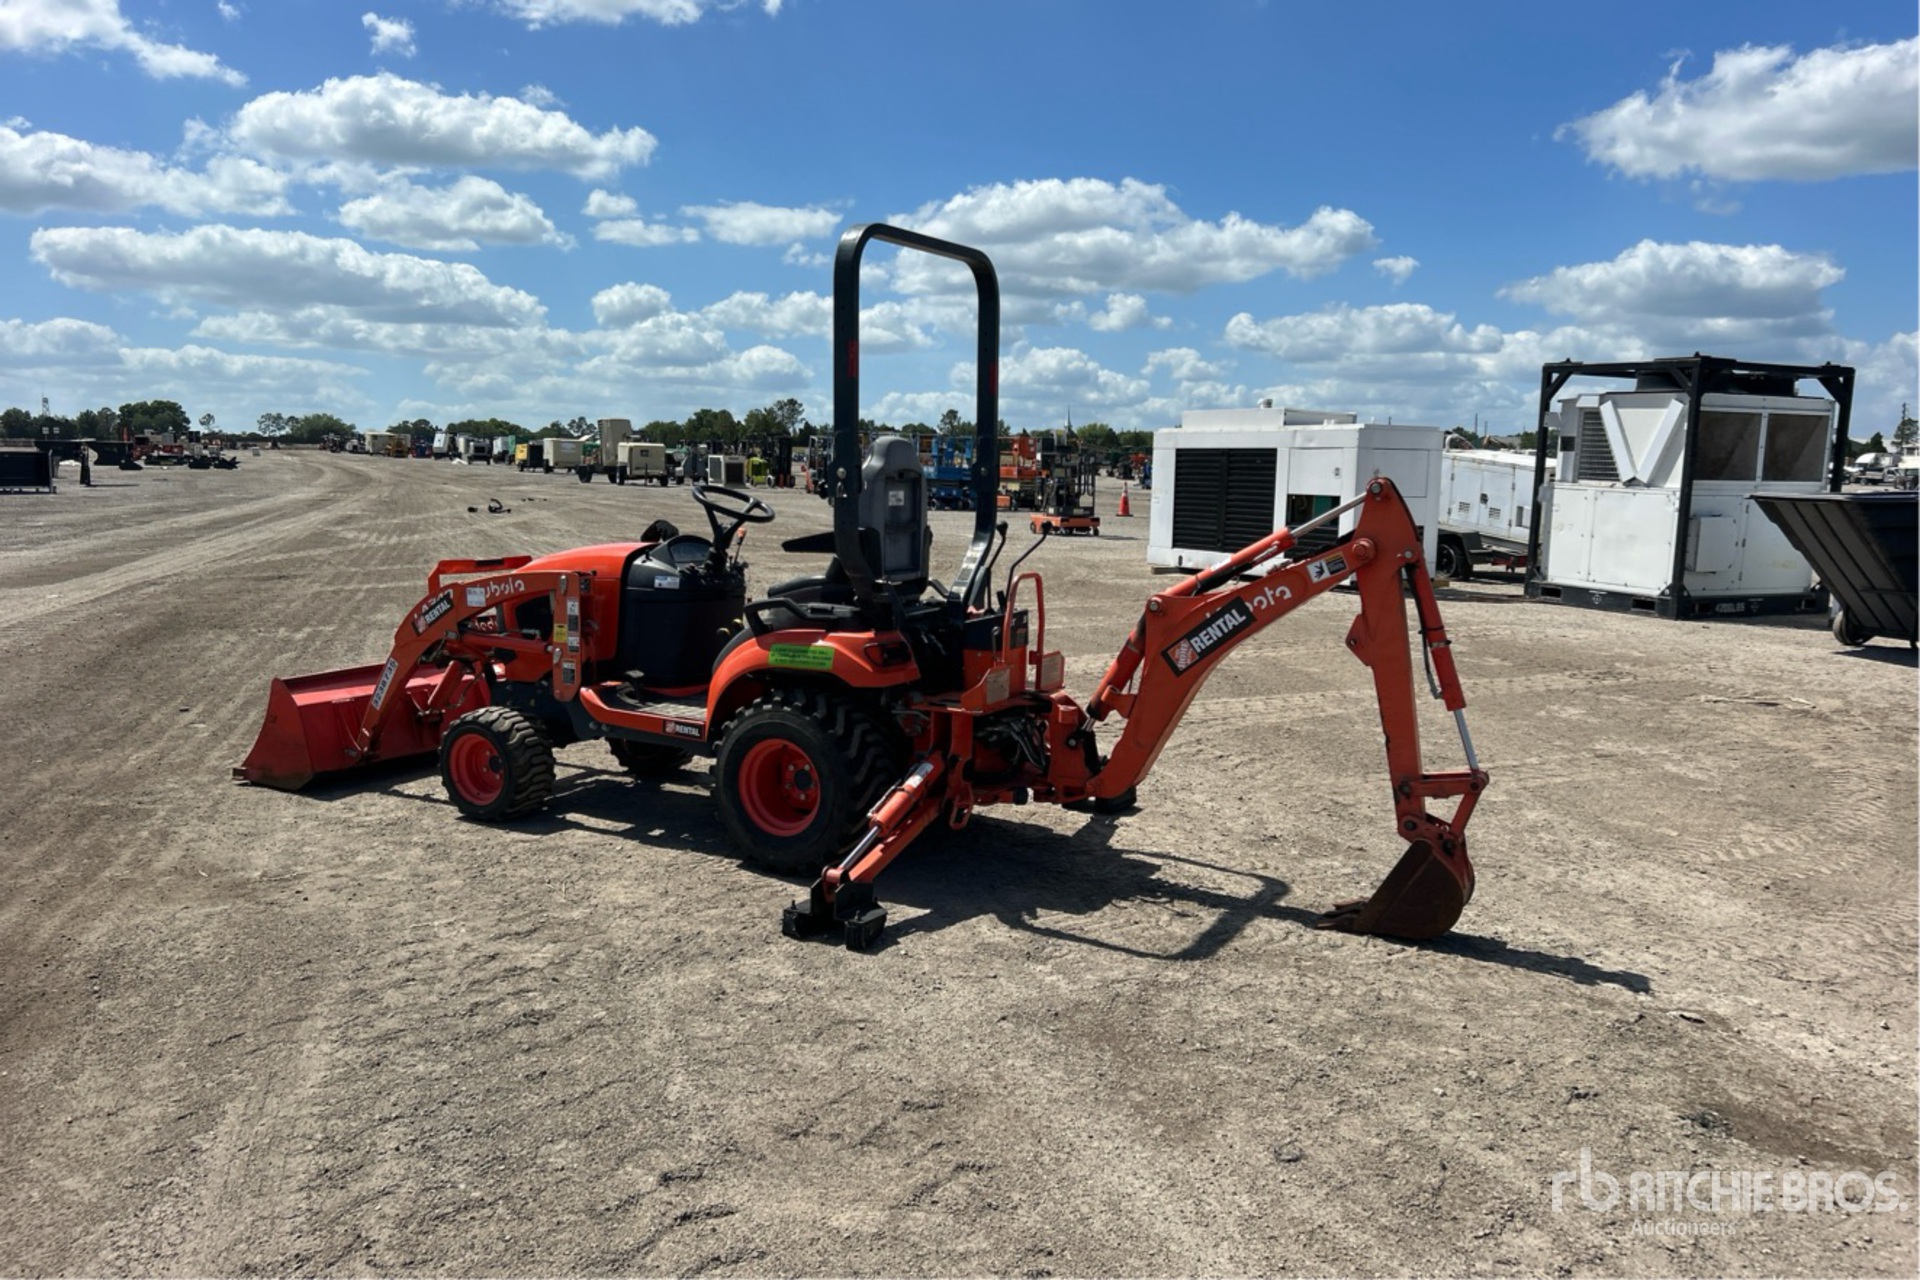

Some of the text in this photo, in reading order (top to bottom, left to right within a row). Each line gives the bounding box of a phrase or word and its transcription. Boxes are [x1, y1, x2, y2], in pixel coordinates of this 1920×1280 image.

[424, 600, 452, 624] RENTAL
[1190, 609, 1246, 653] RENTAL
[675, 724, 700, 737] RENTAL
